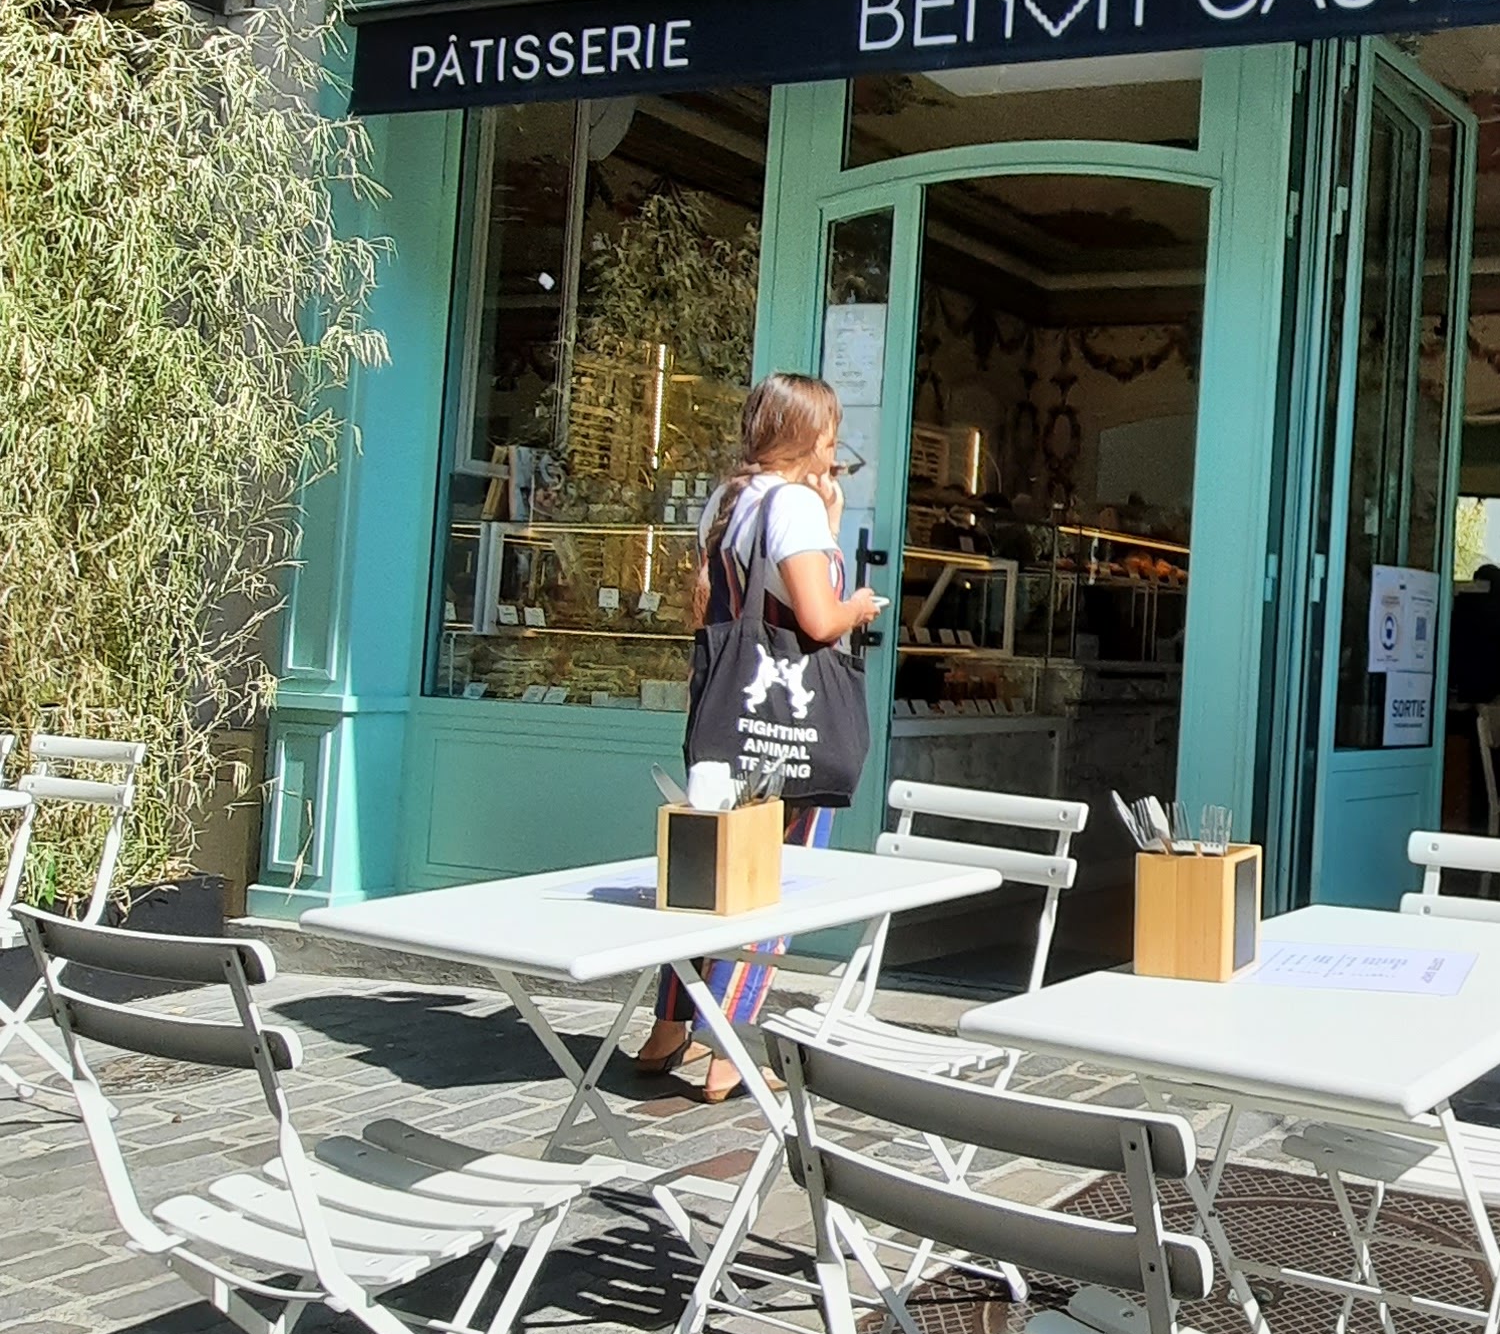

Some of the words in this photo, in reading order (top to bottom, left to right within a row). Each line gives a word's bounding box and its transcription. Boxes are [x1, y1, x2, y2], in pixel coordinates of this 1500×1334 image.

[410, 19, 692, 90] PÂTISSERIE
[1391, 698, 1426, 718] SORTIE
[737, 717, 818, 742] FIGHTING
[743, 737, 811, 760] ANIMAL
[738, 754, 812, 779] TESING
